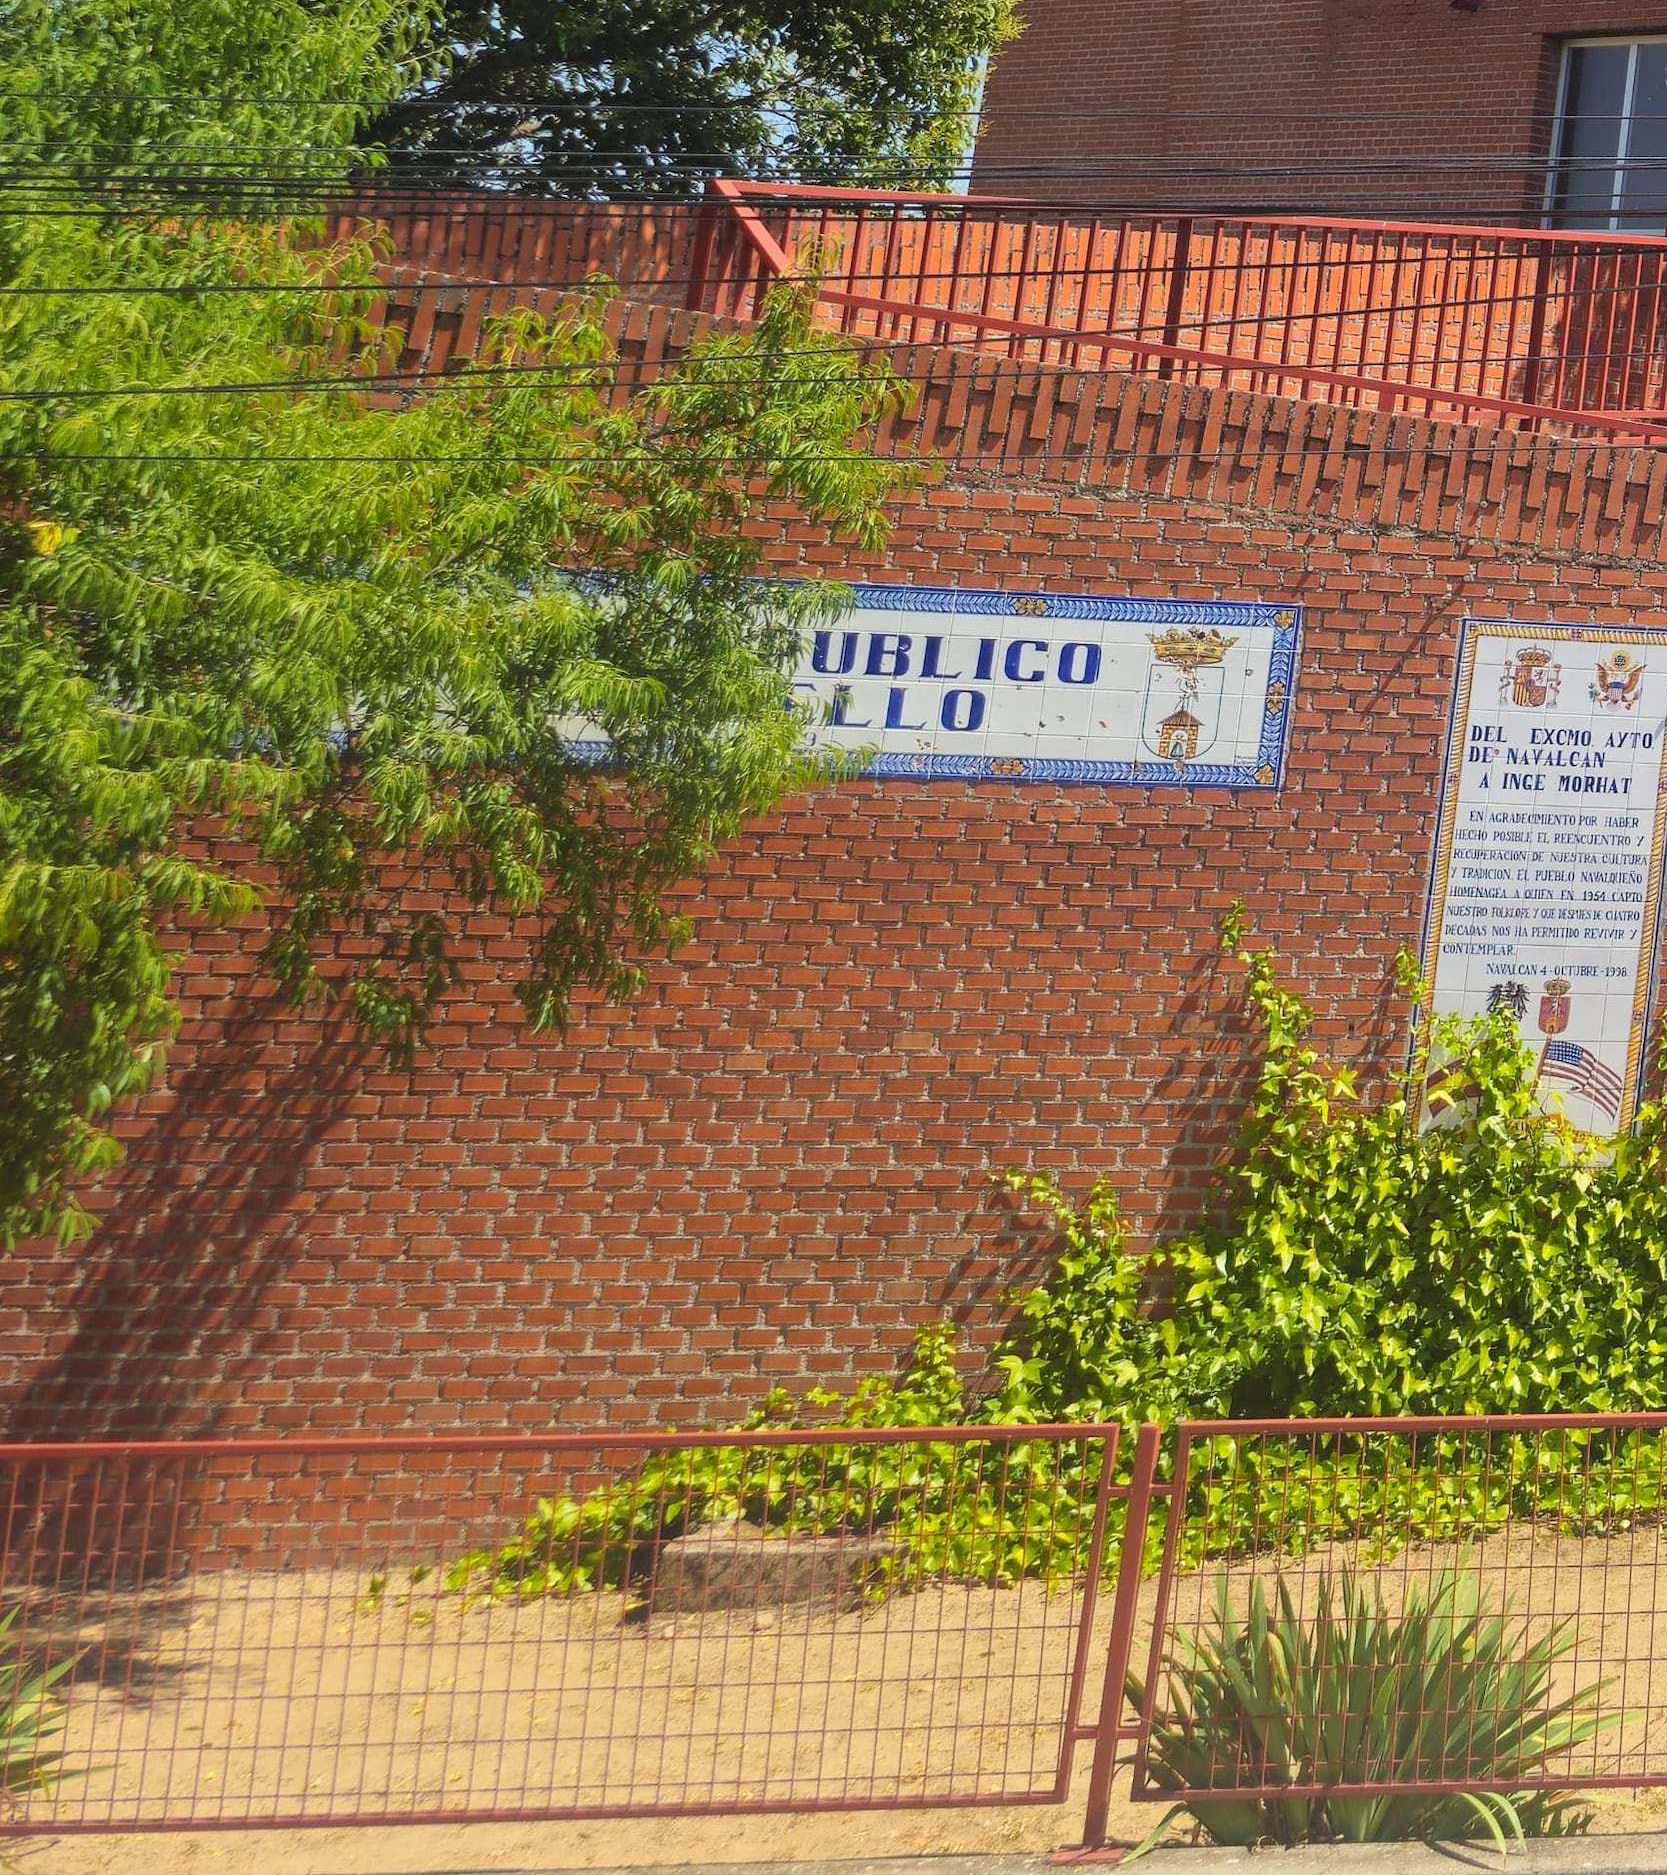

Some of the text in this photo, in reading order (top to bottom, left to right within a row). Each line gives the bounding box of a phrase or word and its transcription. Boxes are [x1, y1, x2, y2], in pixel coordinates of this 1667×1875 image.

[1471, 725, 1507, 743] DEL
[1605, 732, 1655, 750] AYTO.
[1468, 746, 1606, 768] DE NAVALCAN
[1479, 772, 1633, 794] A INGE MORHAT
[1469, 810, 1640, 828] EN AGRADECIMIENTO POR HABER
[1454, 828, 1645, 847] HECHO POSIBLE EL REENCUENTRO Y
[1453, 848, 1648, 866] RECUPERACION DE NUESTRA CULTURA
[1450, 866, 1458, 878] Y
[1517, 869, 1530, 881] EL
[1534, 869, 1575, 882] PUEBLO
[1580, 870, 1643, 884] NAVALQUEÑO
[1449, 885, 1507, 899] HOMENAGEA
[1512, 888, 1520, 899] A
[1524, 888, 1554, 900] QUIEN
[1560, 890, 1574, 901] EN
[1612, 891, 1643, 903] CAPTO
[1446, 905, 1488, 917] NUESTRO
[1532, 908, 1540, 919] Y
[1541, 908, 1556, 920] QUE
[1558, 909, 1592, 920] DESPUES
[1593, 910, 1603, 921] DE
[1605, 910, 1640, 922] CUATRO
[1444, 924, 1638, 940] DECADAS NOS HA PERMITIDO REVIVIR Y
[1486, 963, 1538, 975] NAVALCAN
